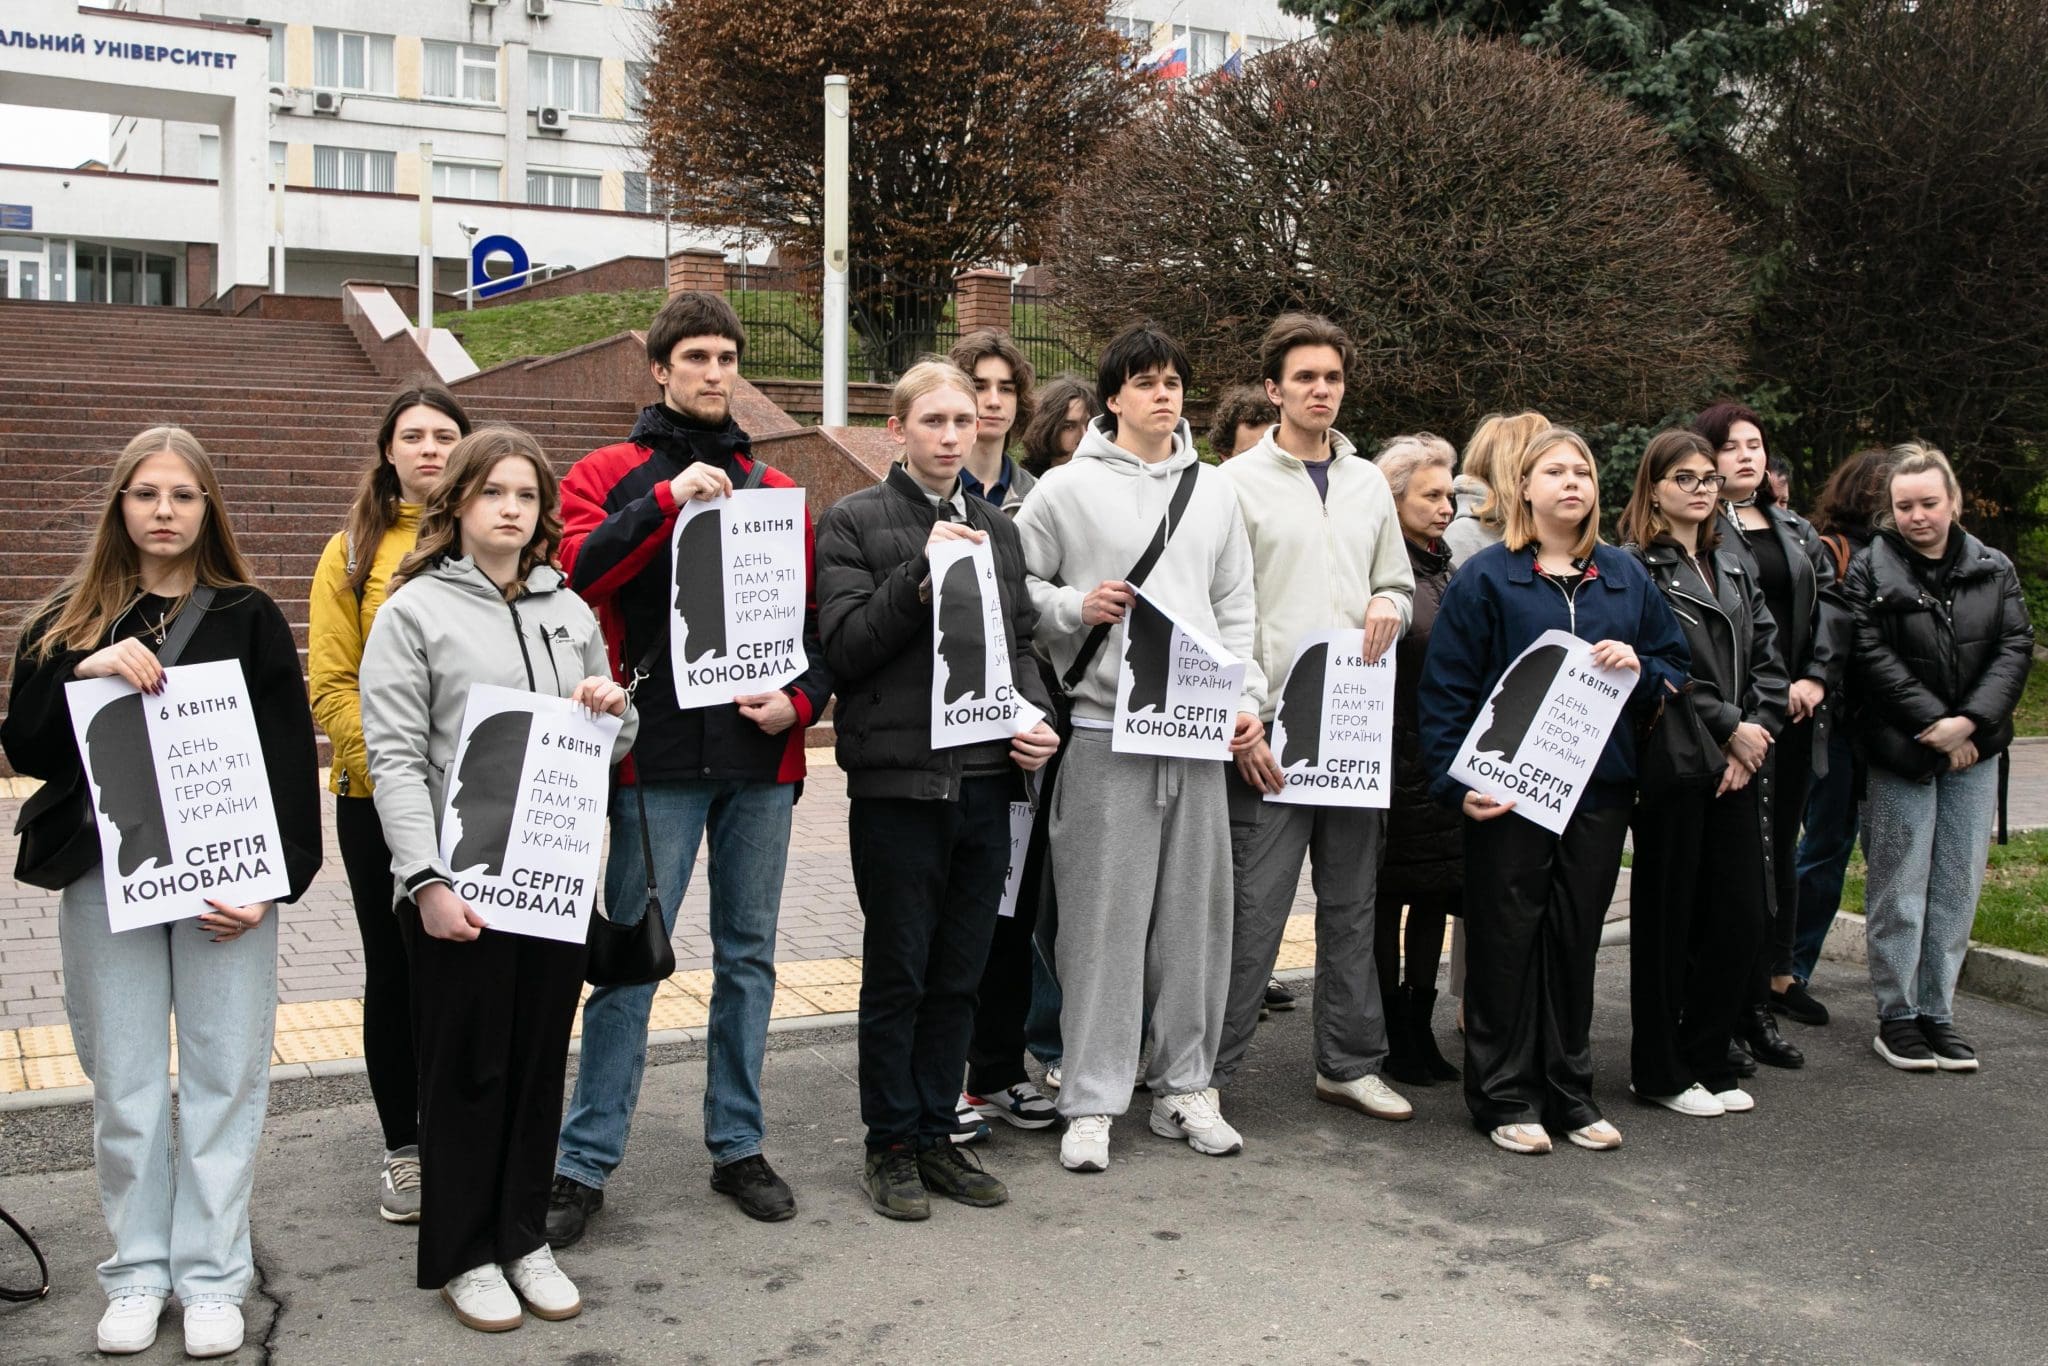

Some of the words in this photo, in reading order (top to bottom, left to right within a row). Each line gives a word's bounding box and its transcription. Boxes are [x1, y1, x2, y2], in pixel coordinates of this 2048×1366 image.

[94, 39, 237, 70] УНІВЕРСИТЕТ
[731, 523, 739, 535] 6
[744, 519, 794, 534] КВІТНЯ
[733, 552, 772, 569] ДЕНЬ
[987, 567, 993, 579] 6
[735, 588, 779, 605] ГЕРОЯ
[735, 605, 796, 624] УКРАЇНИ
[736, 638, 794, 661] СЕРГІЯ
[1335, 656, 1342, 666] 6
[687, 657, 797, 687] КОНОВАЛА
[1178, 657, 1219, 672] ГЕРОЯ
[1177, 674, 1232, 691] УКРАЇНИ
[1332, 683, 1367, 695] ДЕНЬ
[1568, 667, 1576, 678] 6
[1579, 672, 1620, 700] КВІТНЯ
[160, 706, 170, 720] 6
[177, 696, 238, 717] КВІТНЯ
[1173, 704, 1227, 724] СЕРГІЯ
[1554, 693, 1589, 716] ДЕНЬ
[1126, 718, 1224, 741] КОНОВАЛА
[1330, 714, 1368, 726] ГЕРОЯ
[541, 732, 550, 746] 6
[557, 735, 601, 758] КВІТНЯ
[1329, 729, 1382, 743] УКРАЇНИ
[1540, 721, 1580, 747] ГЕРОЯ
[167, 737, 218, 760] ДЕНЬ
[1533, 735, 1586, 769] УКРАЇНИ
[1326, 758, 1381, 775] СЕРГІЯ
[175, 778, 232, 802] ГЕРОЯ
[533, 769, 578, 789] ДЕНЬ
[1466, 755, 1563, 814] КОНОВАЛА
[1519, 762, 1574, 799] СЕРГІЯ
[178, 796, 258, 824] УКРАЇНИ
[526, 809, 576, 831] ГЕРОЯ
[186, 834, 267, 866] СЕРГІЯ
[521, 830, 591, 855] УКРАЇНИ
[122, 858, 271, 904] КОНОВАЛА
[512, 868, 585, 897] СЕРГІЯ
[1170, 1110, 1186, 1126] N
